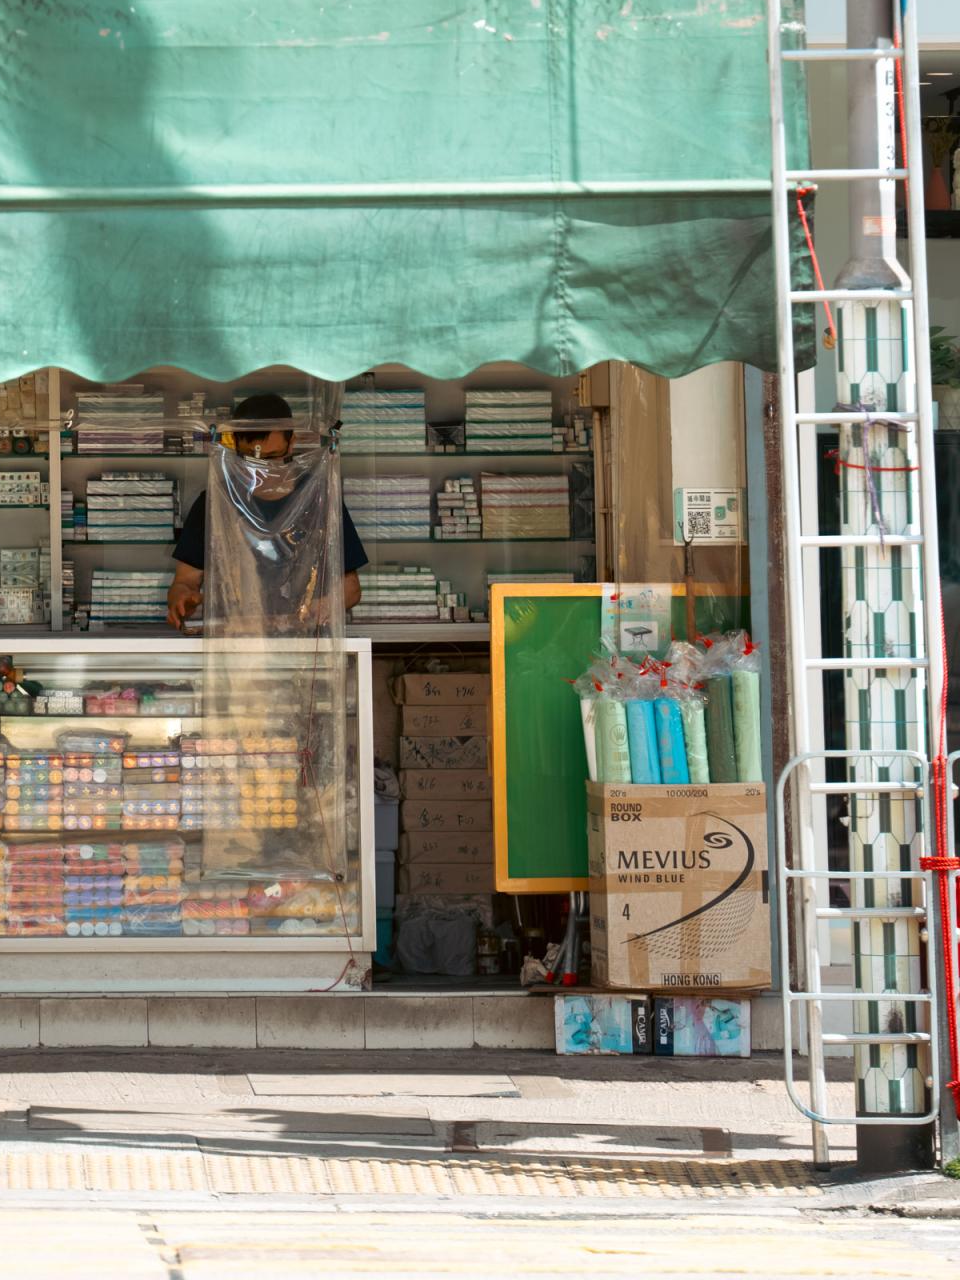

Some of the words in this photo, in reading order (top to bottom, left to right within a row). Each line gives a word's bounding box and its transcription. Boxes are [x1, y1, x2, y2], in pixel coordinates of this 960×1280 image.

[610, 803, 642, 812] ROUND
[611, 813, 642, 822] BOX
[617, 850, 711, 870] MEVIUS
[618, 874, 650, 883] WIND
[656, 874, 685, 883] BLUE
[622, 903, 630, 920] 4
[663, 975, 690, 986] HONG
[693, 975, 720, 986] KONG
